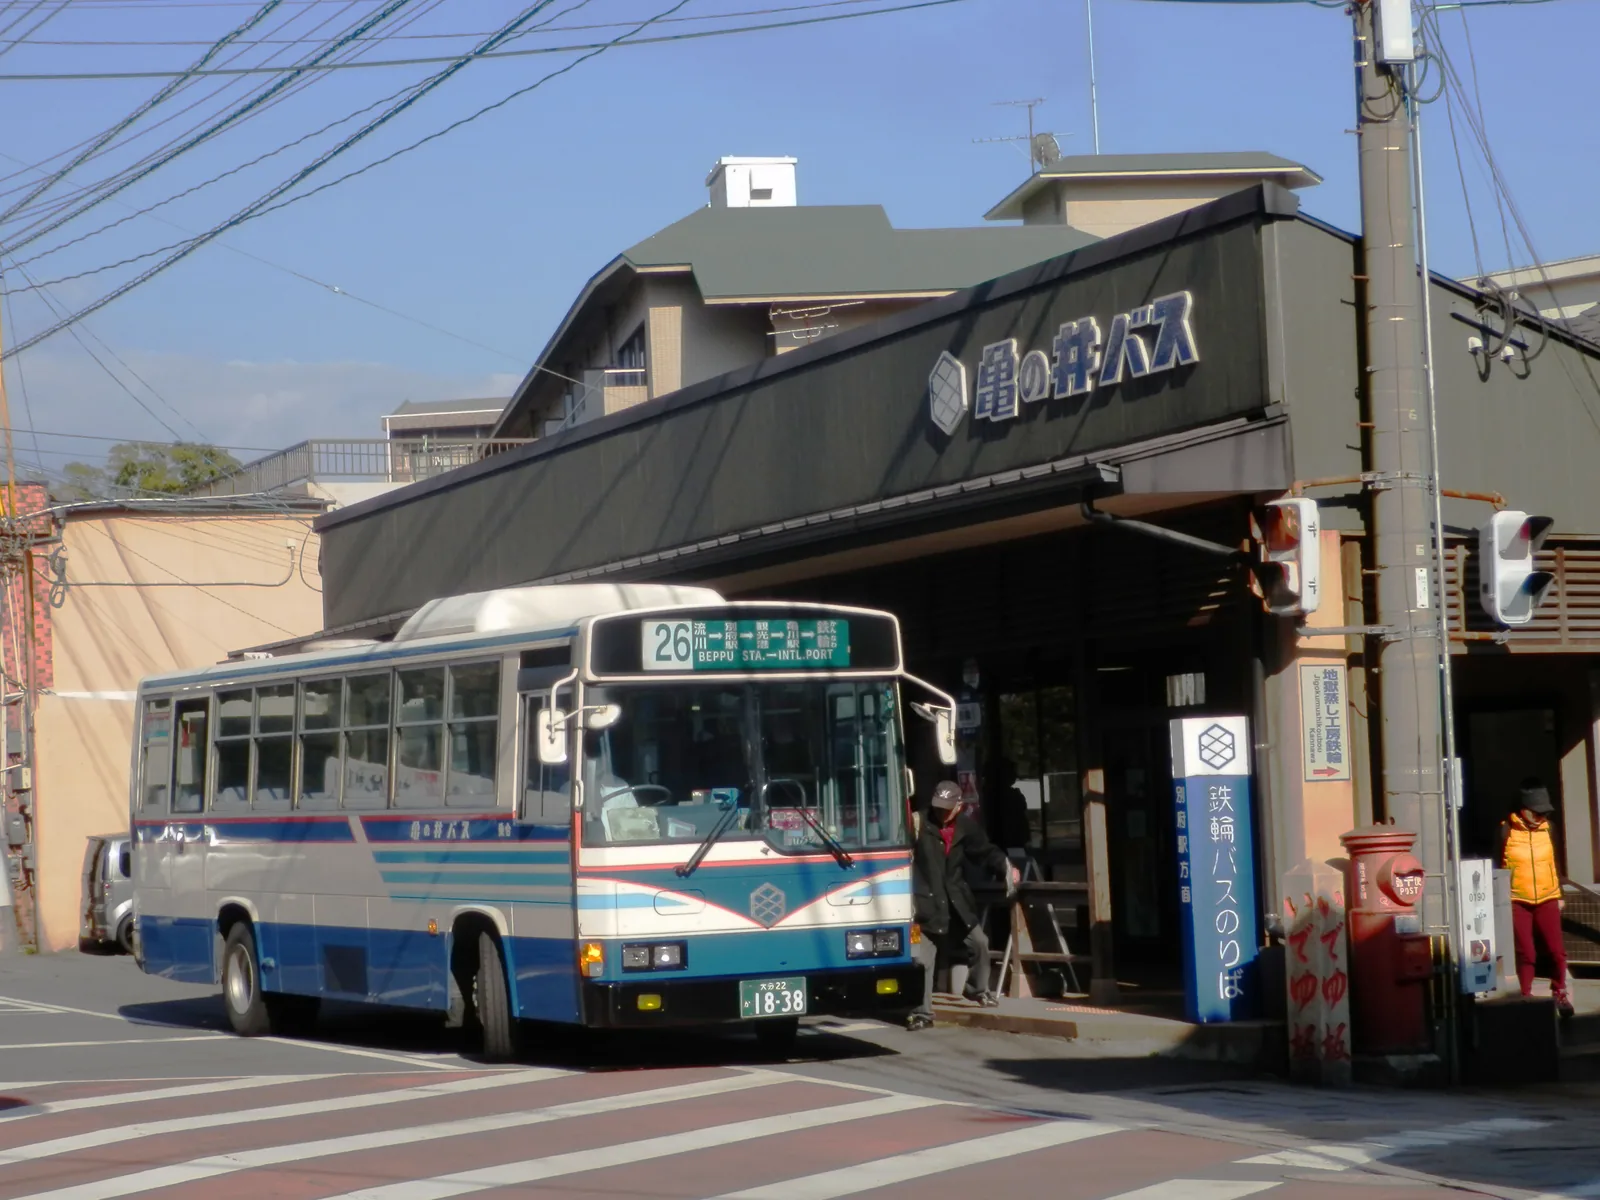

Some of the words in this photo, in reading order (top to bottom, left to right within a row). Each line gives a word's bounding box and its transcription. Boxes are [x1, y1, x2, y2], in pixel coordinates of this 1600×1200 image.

[975, 290, 1200, 422] 亀の井バス
[655, 623, 691, 662] 26
[694, 622, 707, 650] 流川
[724, 622, 738, 649] 別府駅
[756, 622, 769, 649] 観光港
[699, 651, 734, 661] BEPPU
[1175, 786, 1191, 903] 別府駅方面
[1208, 785, 1244, 999] 鉄輪バスのりば
[1400, 886, 1419, 895] POST
[755, 990, 803, 1014] 18-38
